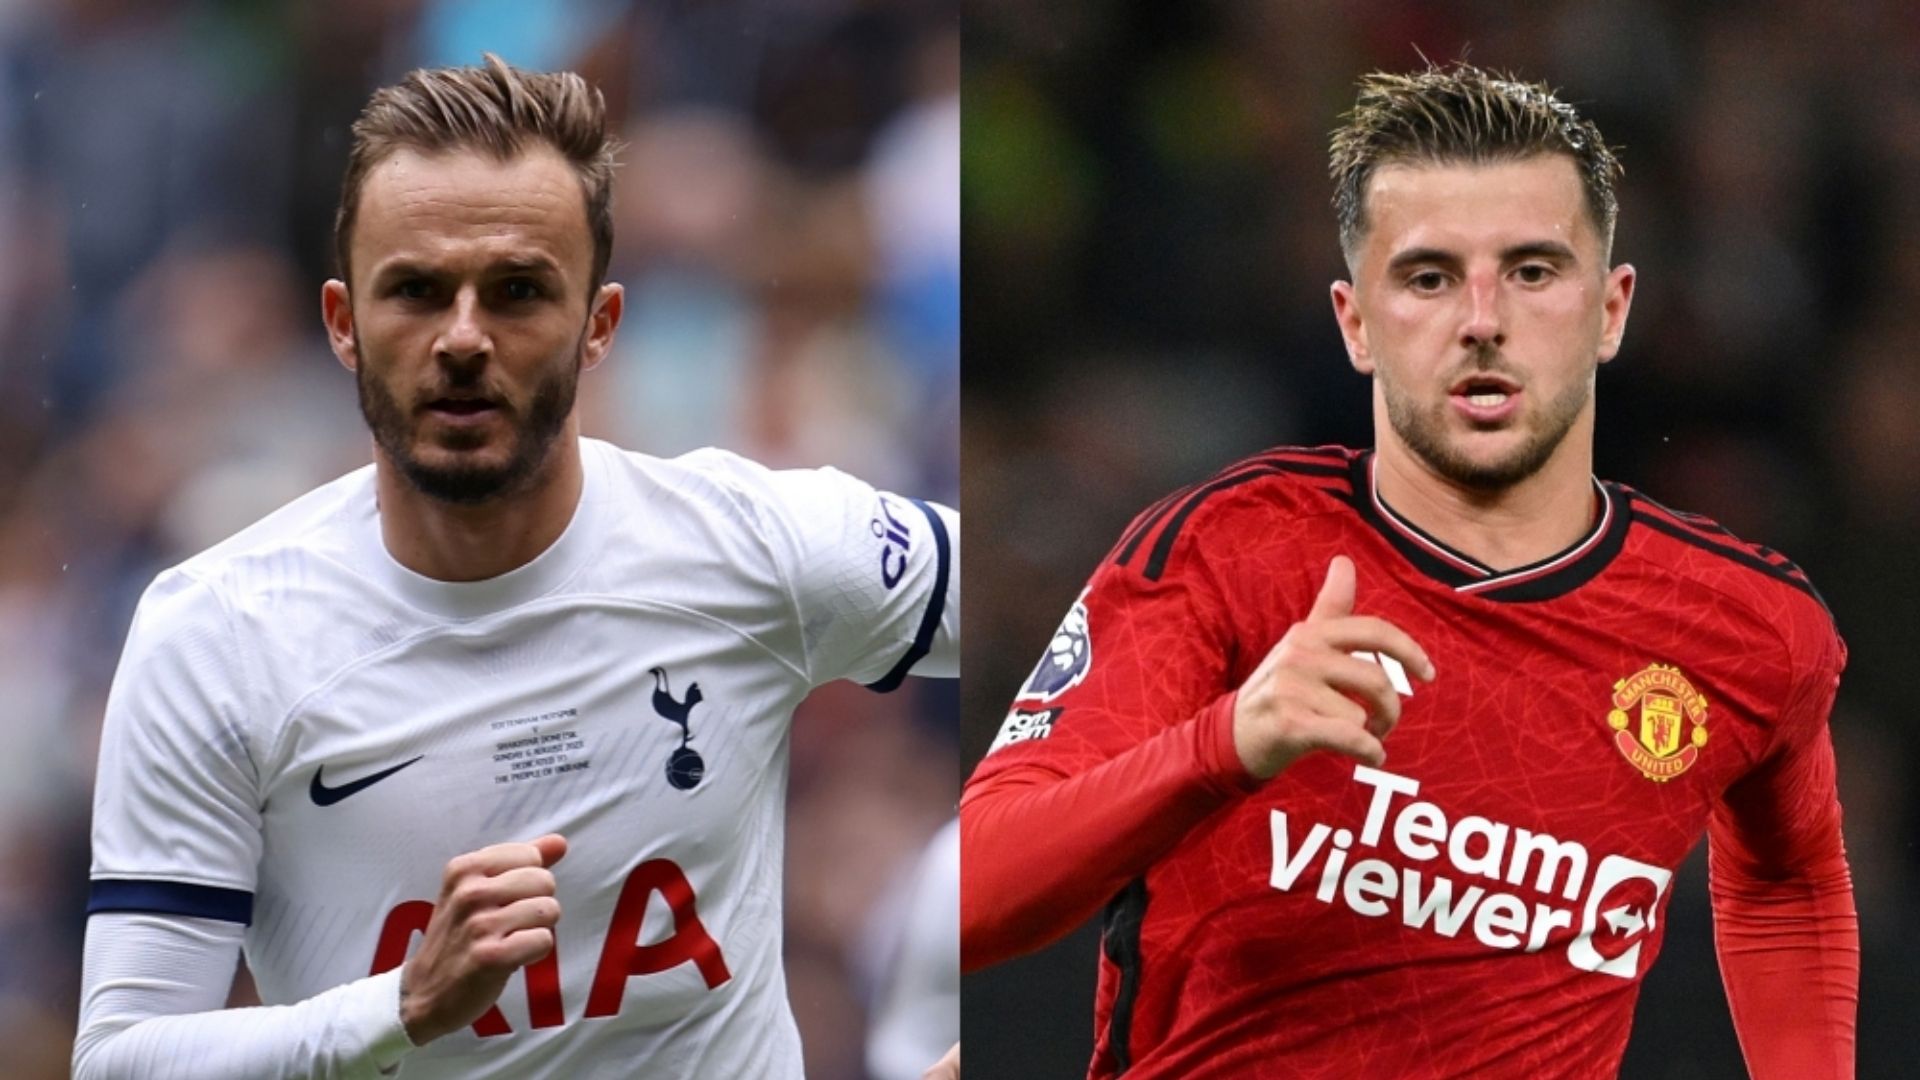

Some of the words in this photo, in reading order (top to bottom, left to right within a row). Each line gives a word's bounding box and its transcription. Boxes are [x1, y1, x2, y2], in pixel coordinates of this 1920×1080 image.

[1622, 673, 1701, 717] MANCHESTER
[1632, 749, 1683, 774] UNITED
[1352, 764, 1589, 901] Team
[1269, 808, 1572, 953] Viewer
